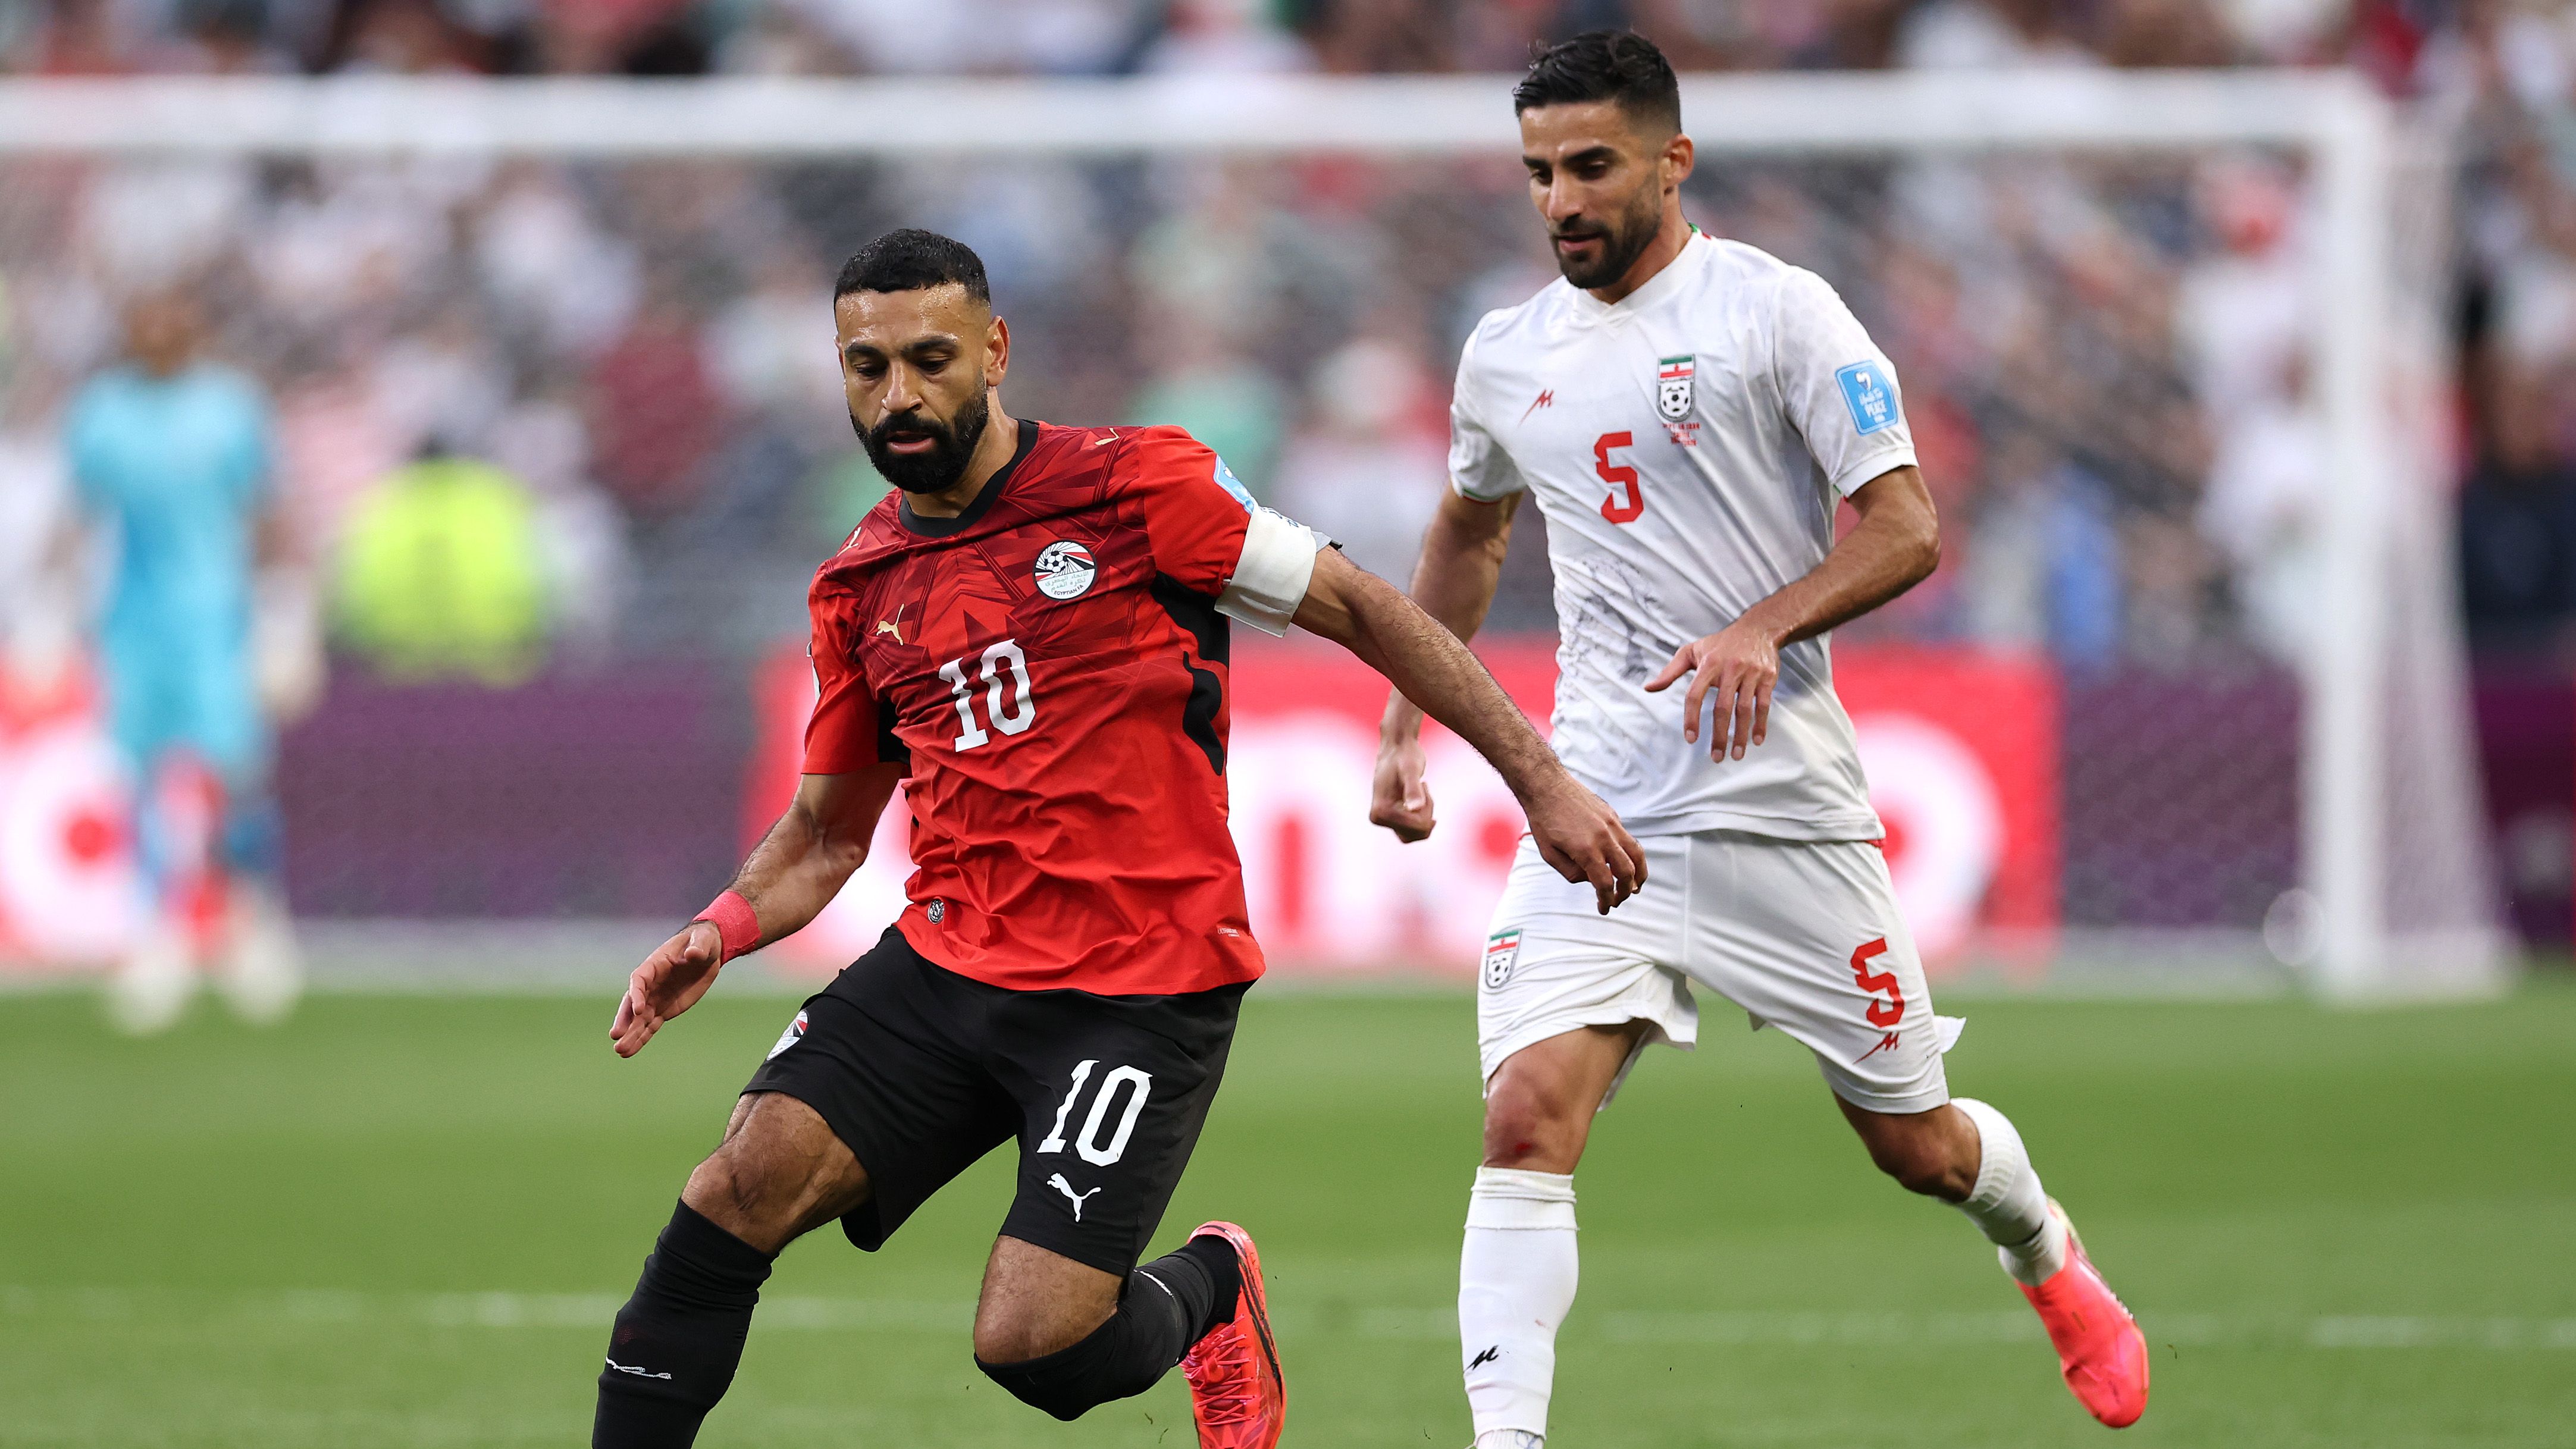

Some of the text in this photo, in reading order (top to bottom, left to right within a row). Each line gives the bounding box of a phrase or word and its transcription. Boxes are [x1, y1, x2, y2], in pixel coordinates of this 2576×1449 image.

[1594, 431, 1644, 524] 5
[939, 638, 1036, 752] 10
[1850, 937, 1905, 1028] 5
[1037, 1059, 1154, 1167] 10
